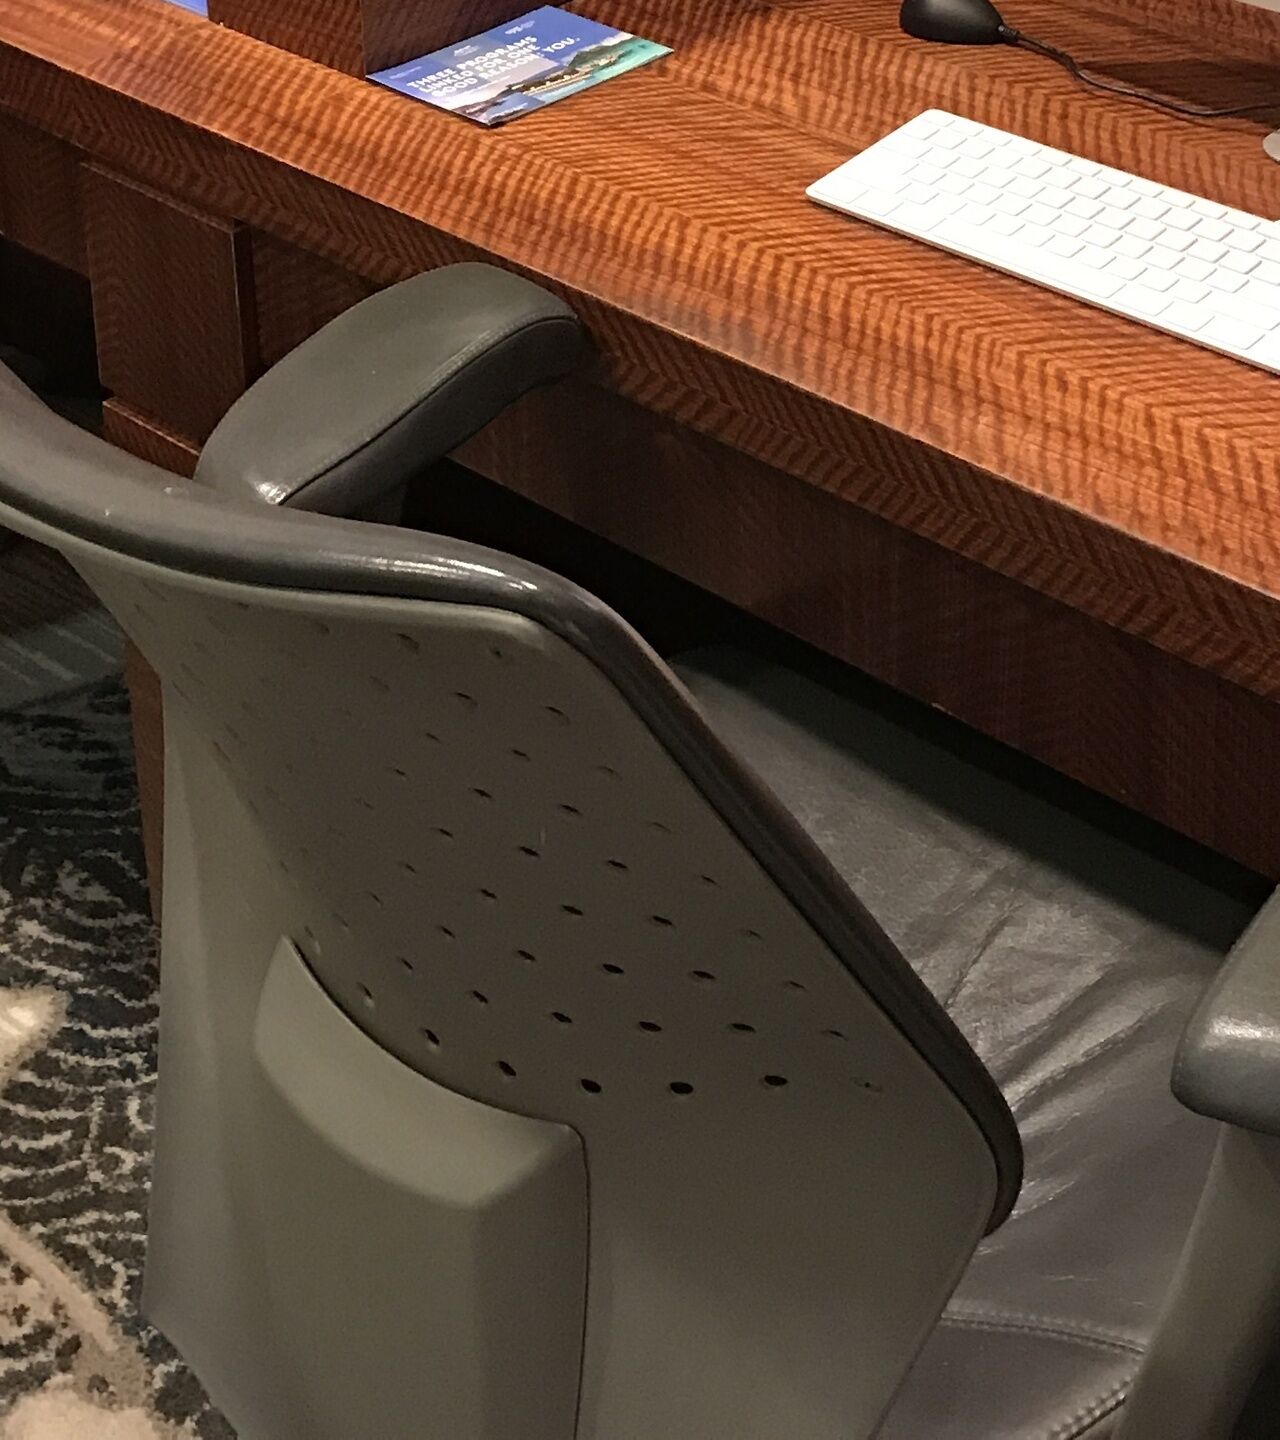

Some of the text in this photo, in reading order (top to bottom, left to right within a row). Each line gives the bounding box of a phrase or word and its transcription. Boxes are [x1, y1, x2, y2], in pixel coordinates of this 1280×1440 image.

[406, 67, 458, 89] THREE
[456, 35, 539, 71] PROGRAMS
[418, 69, 475, 94] LINKED
[475, 57, 508, 73] FOR
[509, 44, 542, 60] ONE
[431, 76, 479, 98] GOOD
